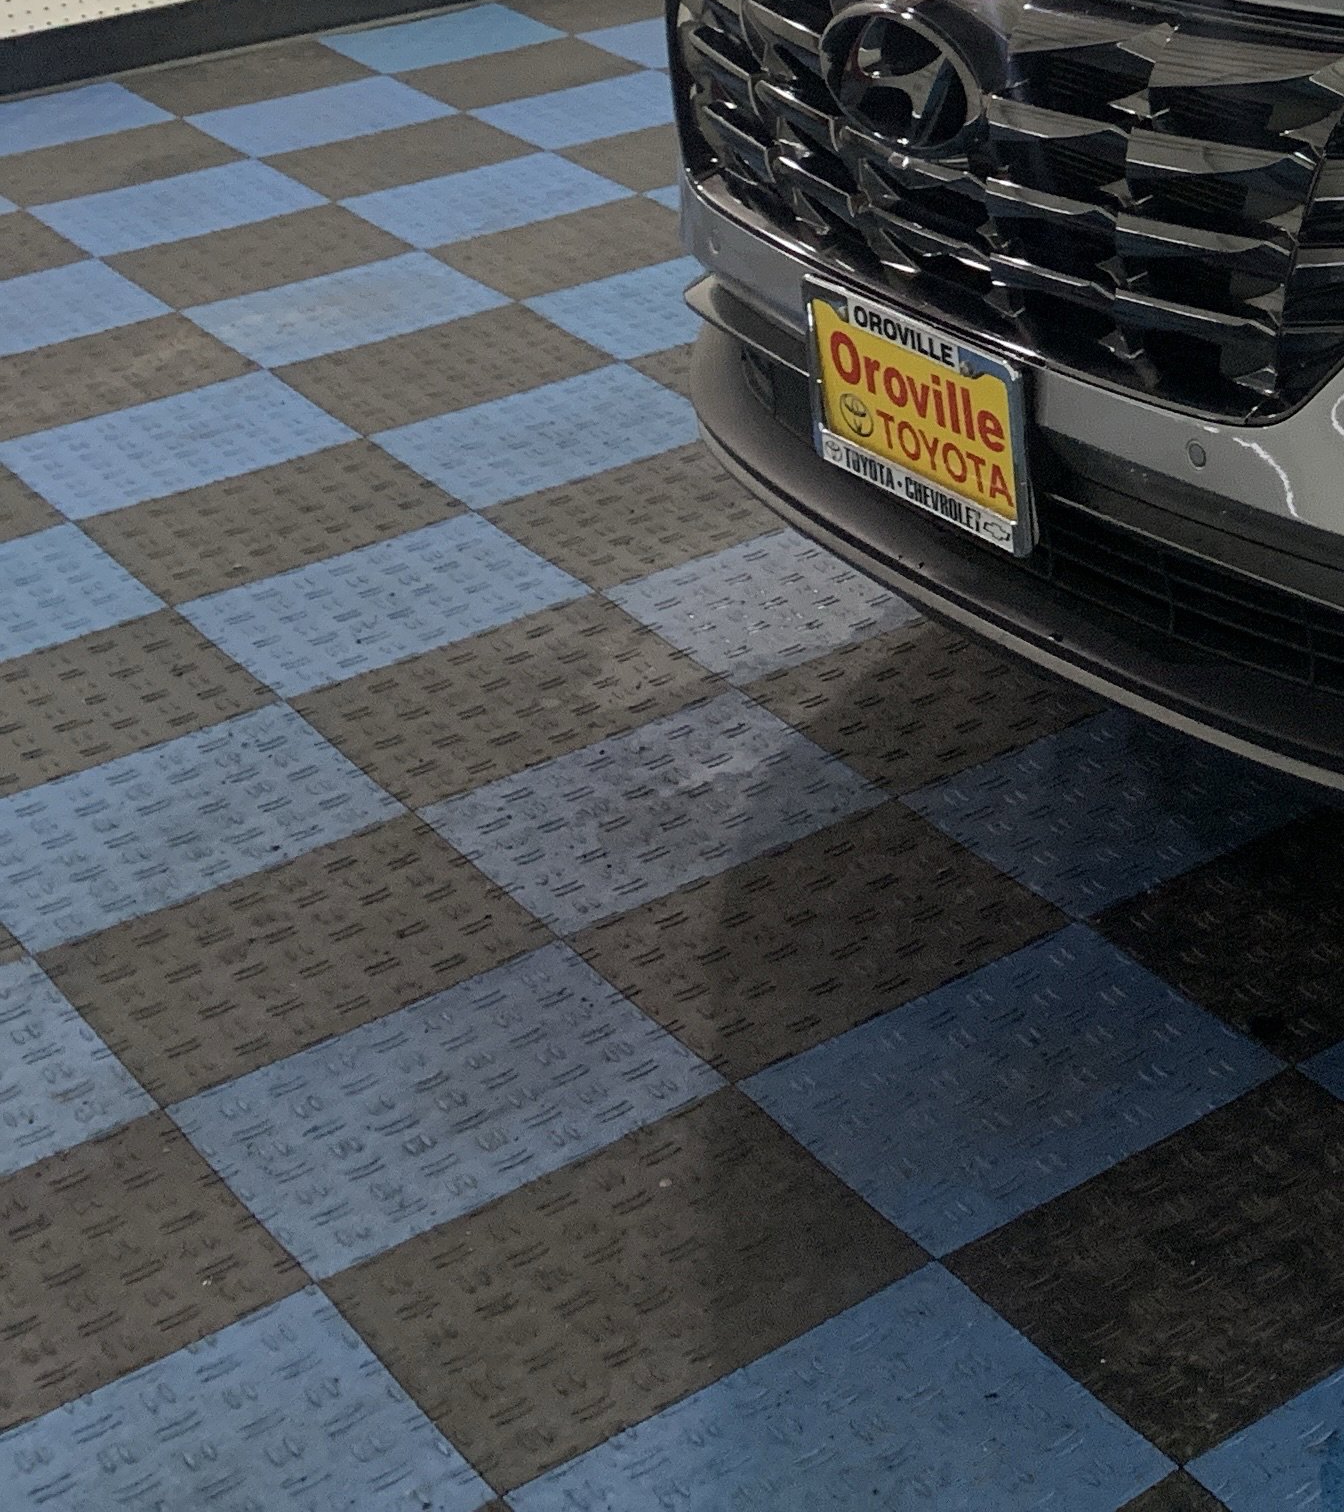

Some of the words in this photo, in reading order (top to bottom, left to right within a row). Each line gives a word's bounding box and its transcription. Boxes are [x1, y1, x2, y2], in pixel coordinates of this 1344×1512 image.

[854, 305, 955, 368] OROVILLE
[830, 330, 1006, 453] Oroville
[842, 446, 896, 490] TOYOTA
[904, 476, 982, 534] CHEVROLET
[876, 409, 1015, 508] TOYOTA
